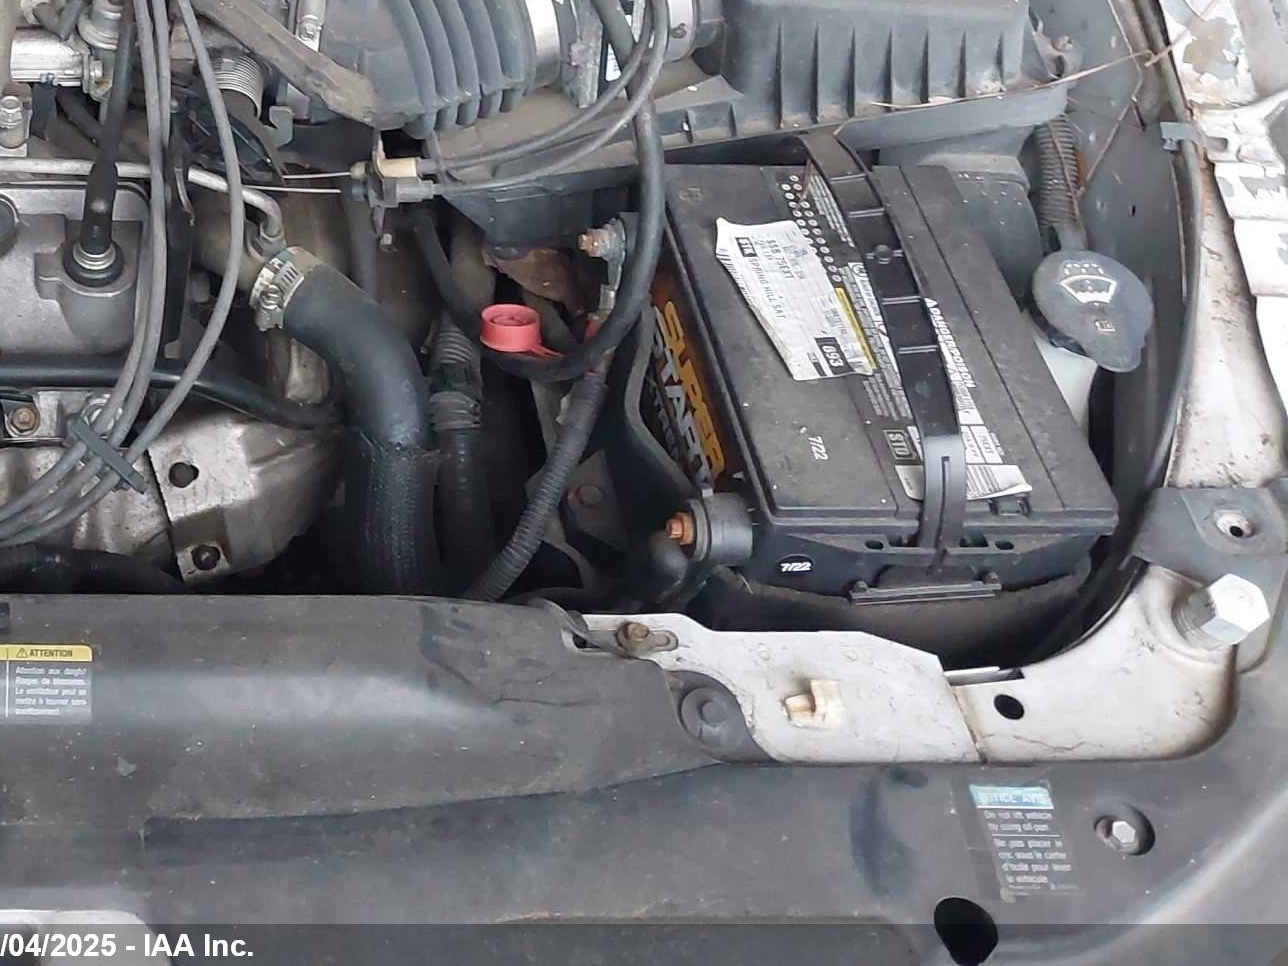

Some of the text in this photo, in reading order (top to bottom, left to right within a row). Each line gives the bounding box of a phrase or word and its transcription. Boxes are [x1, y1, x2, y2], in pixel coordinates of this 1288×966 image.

[664, 300, 725, 475] SUPER
[808, 435, 829, 460] 7/22
[780, 561, 812, 572] 7/22
[29, 649, 73, 658] ATTENTION
